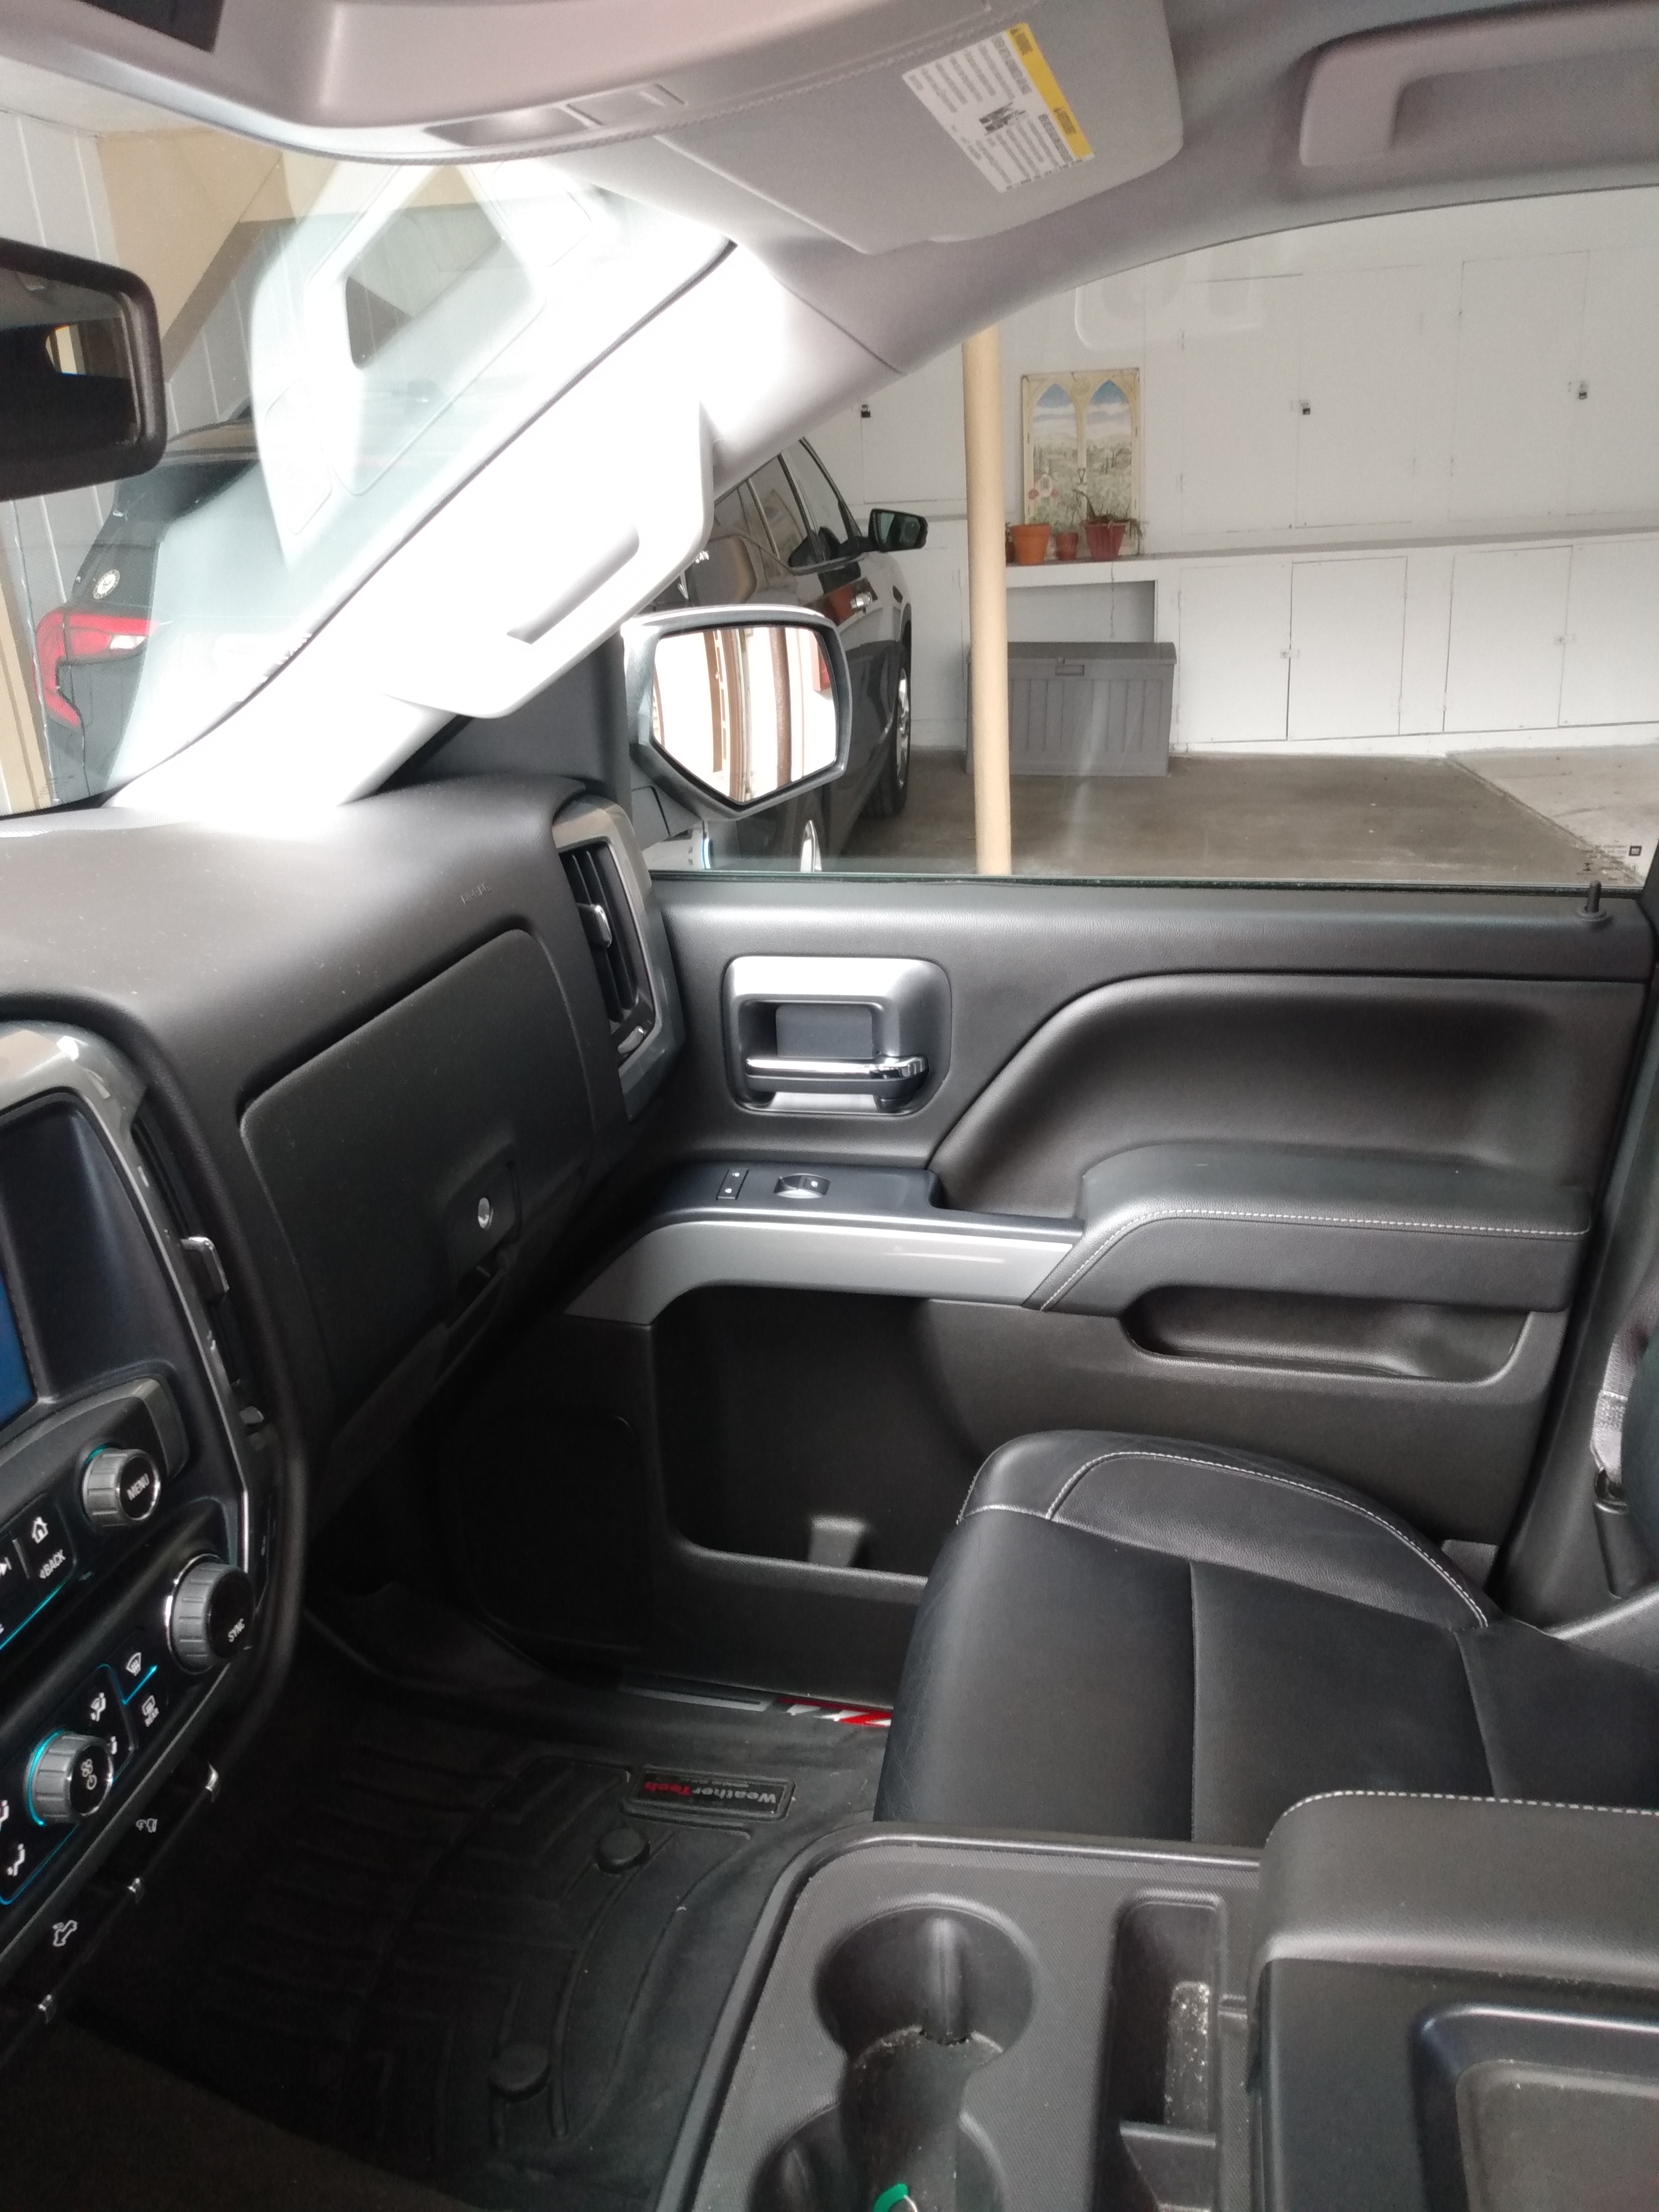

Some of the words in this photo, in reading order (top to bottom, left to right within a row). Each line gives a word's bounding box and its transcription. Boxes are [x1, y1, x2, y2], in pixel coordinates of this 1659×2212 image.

[127, 1473, 149, 1501] MENU
[43, 1549, 66, 1577] BACK
[228, 1618, 245, 1643] SYNC
